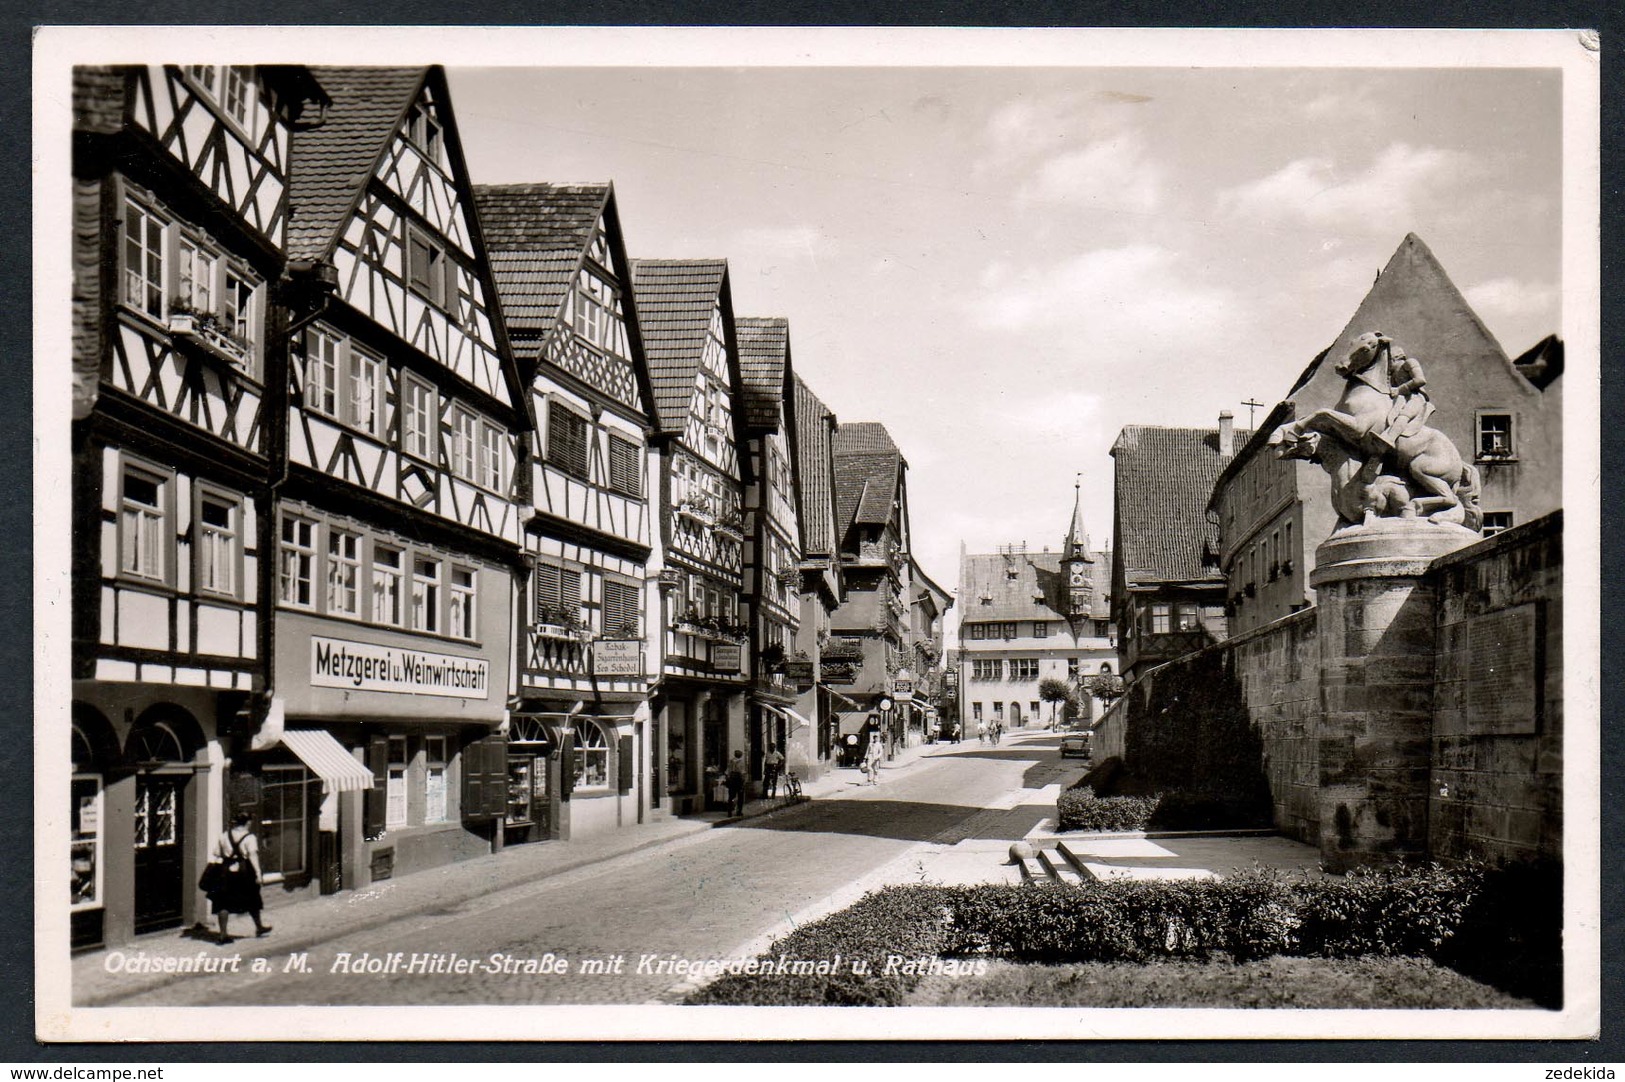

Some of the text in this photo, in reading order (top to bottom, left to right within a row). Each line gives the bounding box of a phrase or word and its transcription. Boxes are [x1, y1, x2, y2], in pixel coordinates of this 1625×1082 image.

[316, 641, 486, 690] Metzgerei u. Weinwirtschaft
